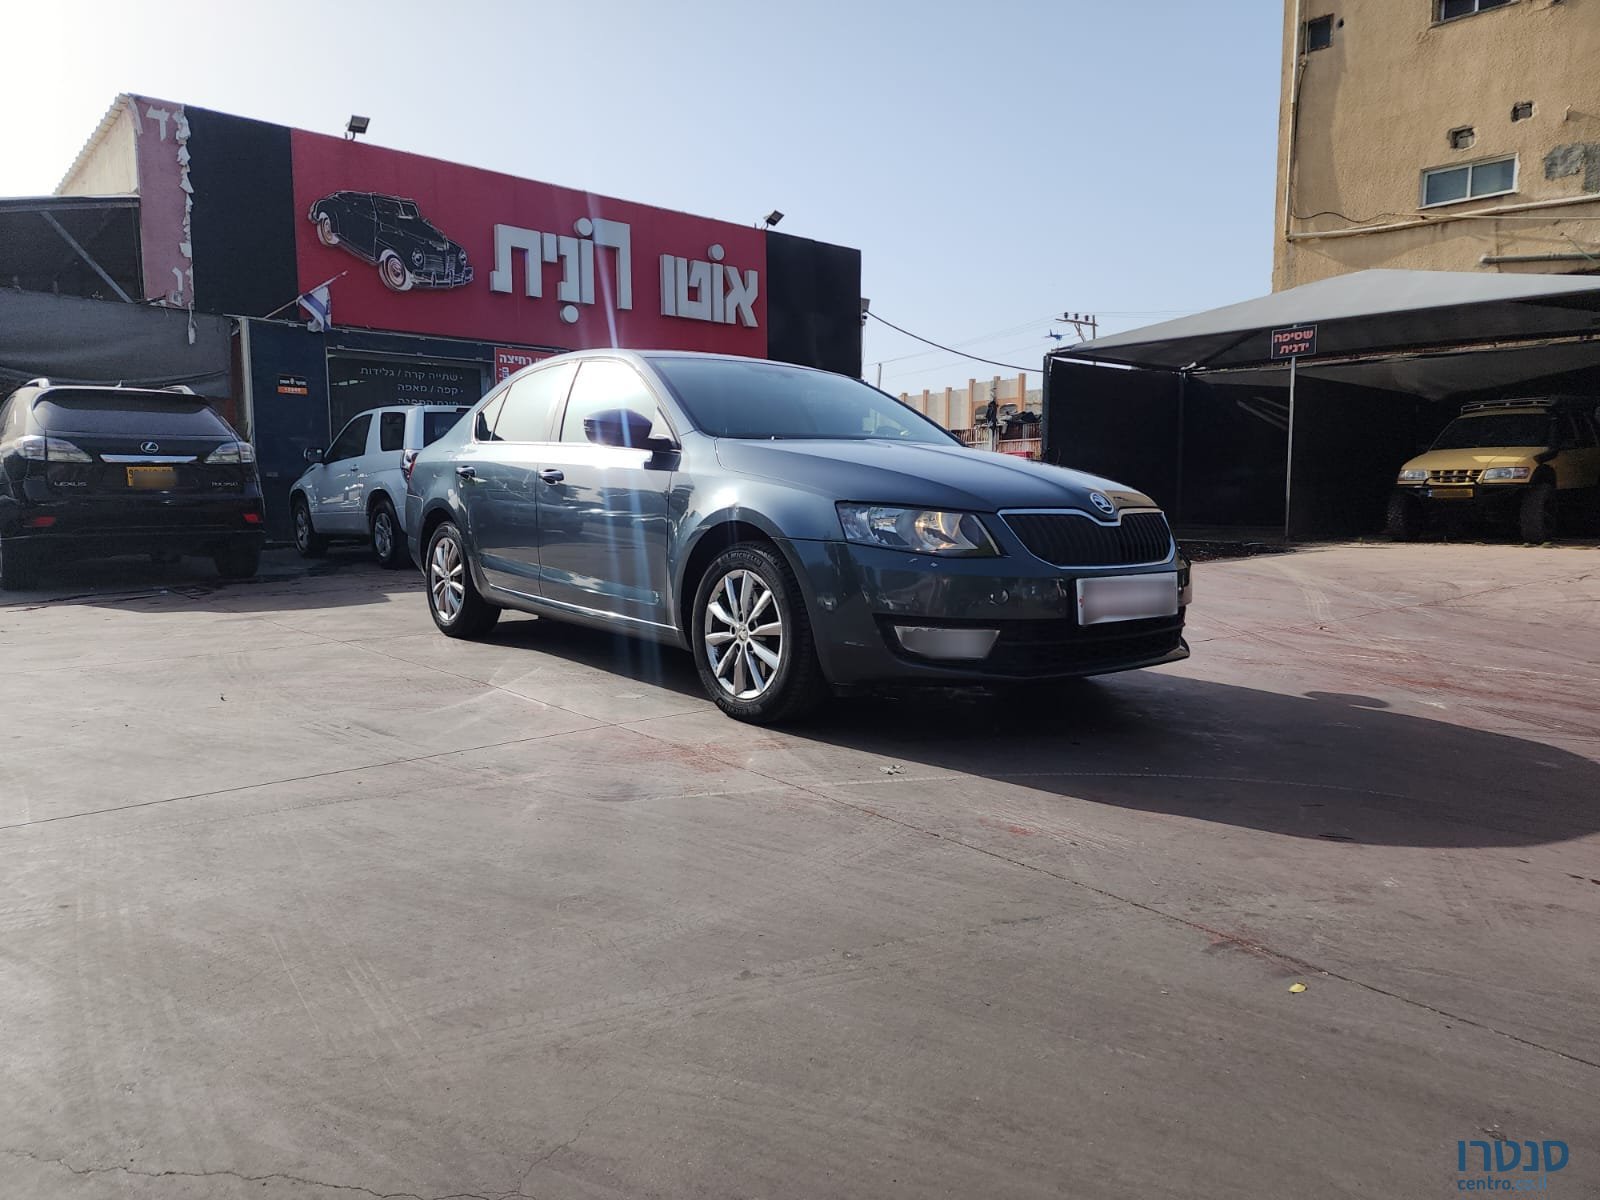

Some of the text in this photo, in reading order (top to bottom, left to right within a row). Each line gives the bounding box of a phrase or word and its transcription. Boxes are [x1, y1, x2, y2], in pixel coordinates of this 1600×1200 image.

[1279, 343, 1310, 354] ידנית
[499, 354, 532, 365] רחיצה
[360, 367, 395, 377] גלידות
[404, 370, 425, 381] קרה
[429, 372, 458, 381] שתייה
[397, 383, 428, 392] מאפה
[437, 385, 459, 396] קפה
